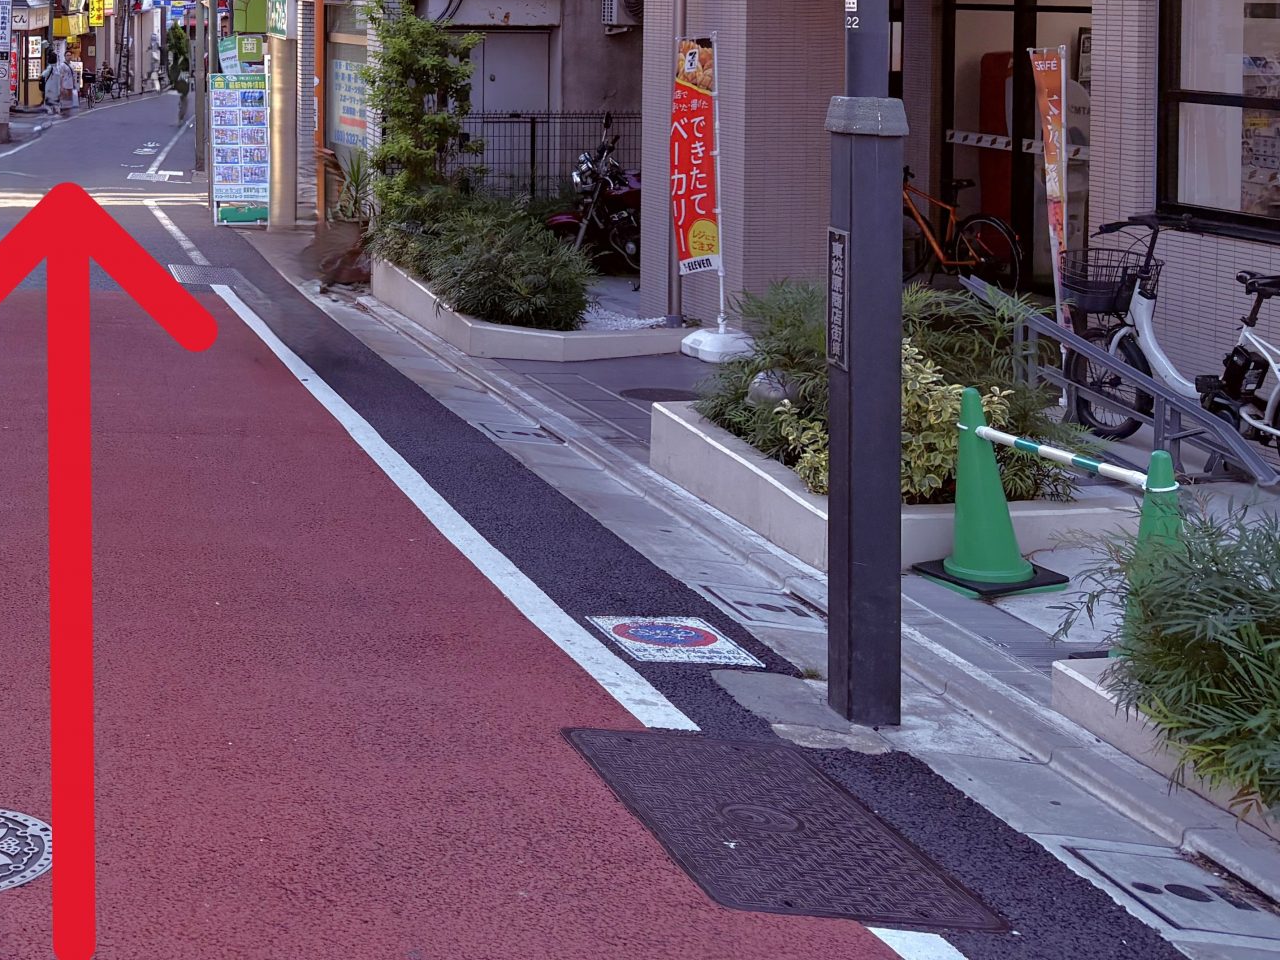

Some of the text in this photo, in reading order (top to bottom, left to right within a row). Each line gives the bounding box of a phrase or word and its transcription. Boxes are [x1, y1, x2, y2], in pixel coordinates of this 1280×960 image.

[670, 116, 689, 252] ベーカリー
[690, 115, 707, 215] できたて
